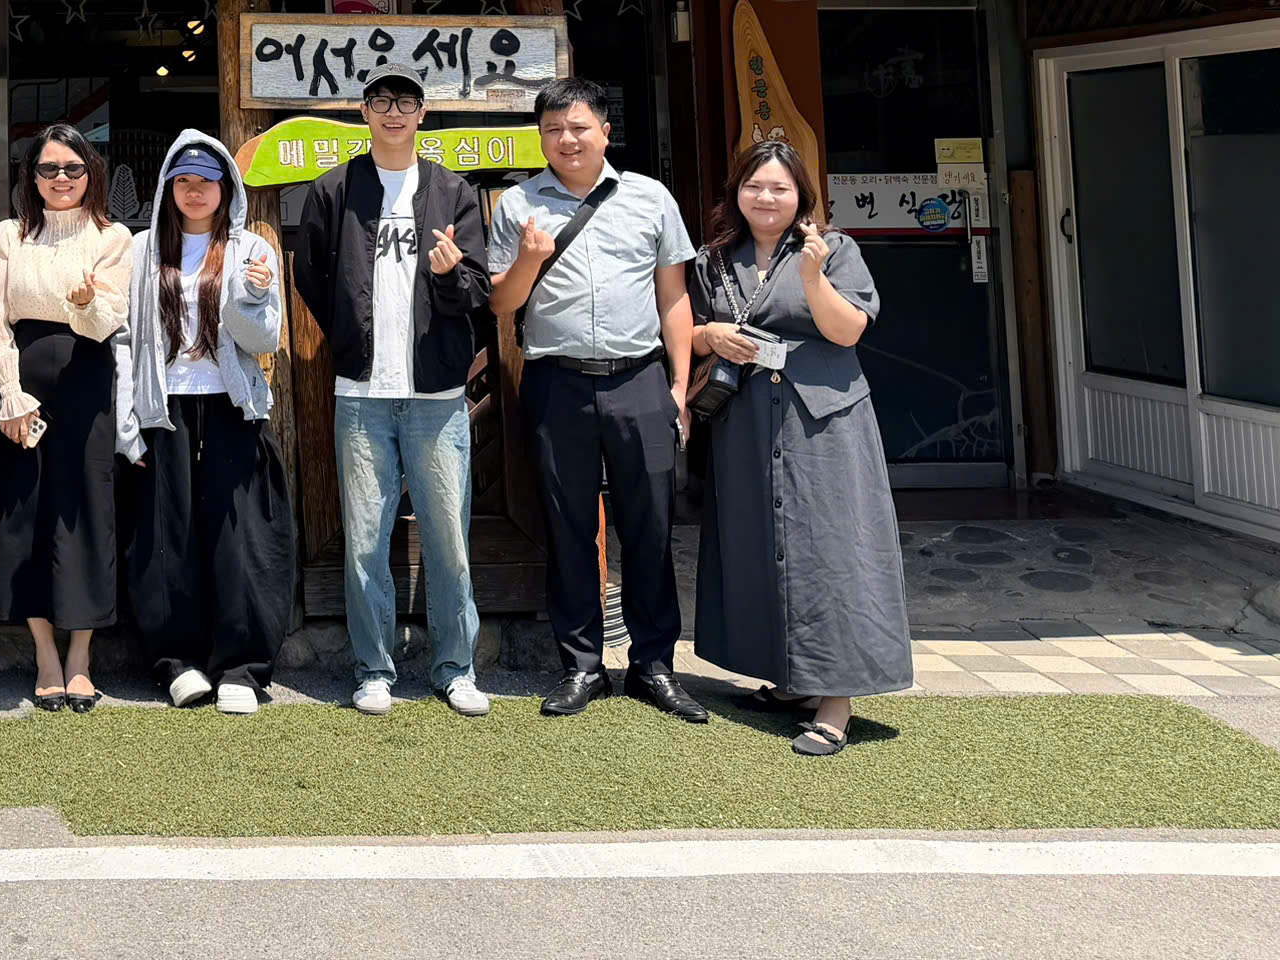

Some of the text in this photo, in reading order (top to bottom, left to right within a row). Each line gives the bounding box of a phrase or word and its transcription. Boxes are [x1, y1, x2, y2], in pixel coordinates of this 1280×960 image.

[255, 27, 559, 98] 어서오세요
[832, 175, 858, 185] 천문동
[913, 175, 938, 185] 전문점
